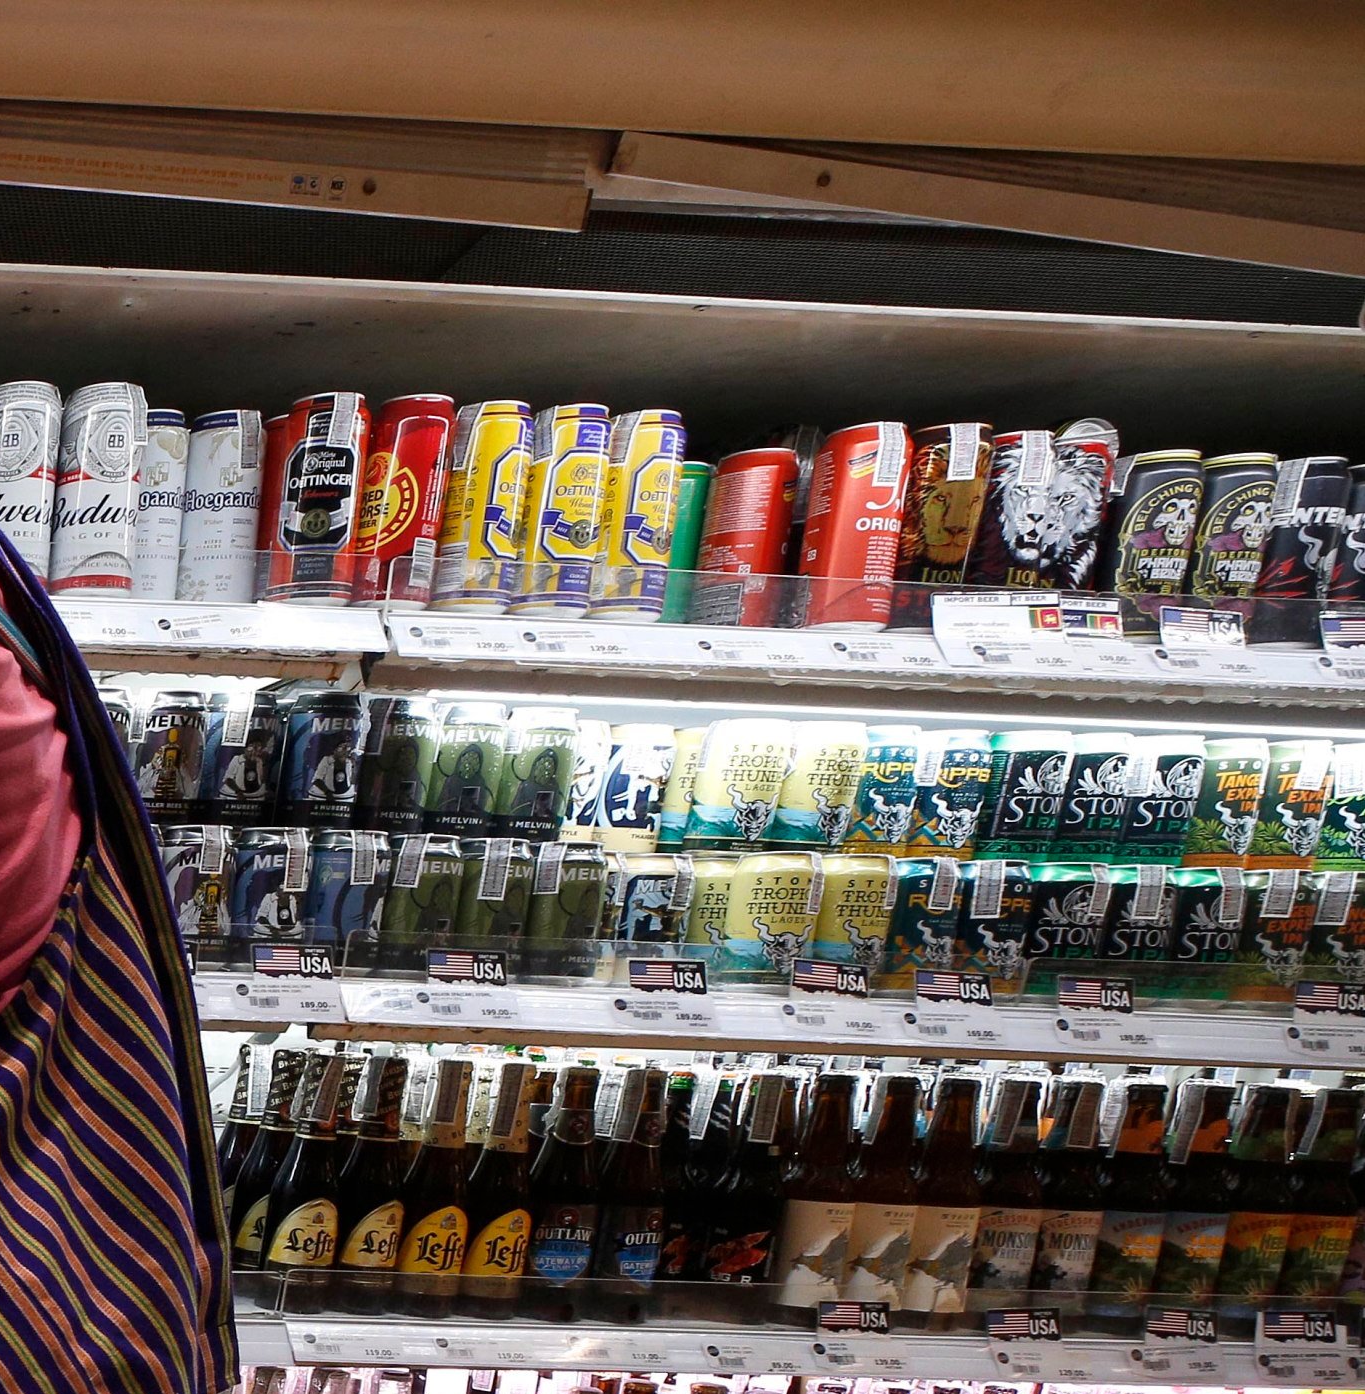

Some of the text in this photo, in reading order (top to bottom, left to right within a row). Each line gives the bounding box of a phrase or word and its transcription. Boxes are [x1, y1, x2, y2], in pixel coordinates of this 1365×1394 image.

[922, 567, 962, 584] LION
[944, 596, 976, 604] IMPORT
[299, 957, 332, 974] USA
[472, 963, 505, 981] USA
[673, 972, 704, 989] USA
[837, 974, 867, 992] USA
[960, 982, 991, 999] USA
[1100, 990, 1130, 1007] USA
[300, 1001, 329, 1009] 189.00
[534, 1228, 593, 1242] OUTLAW
